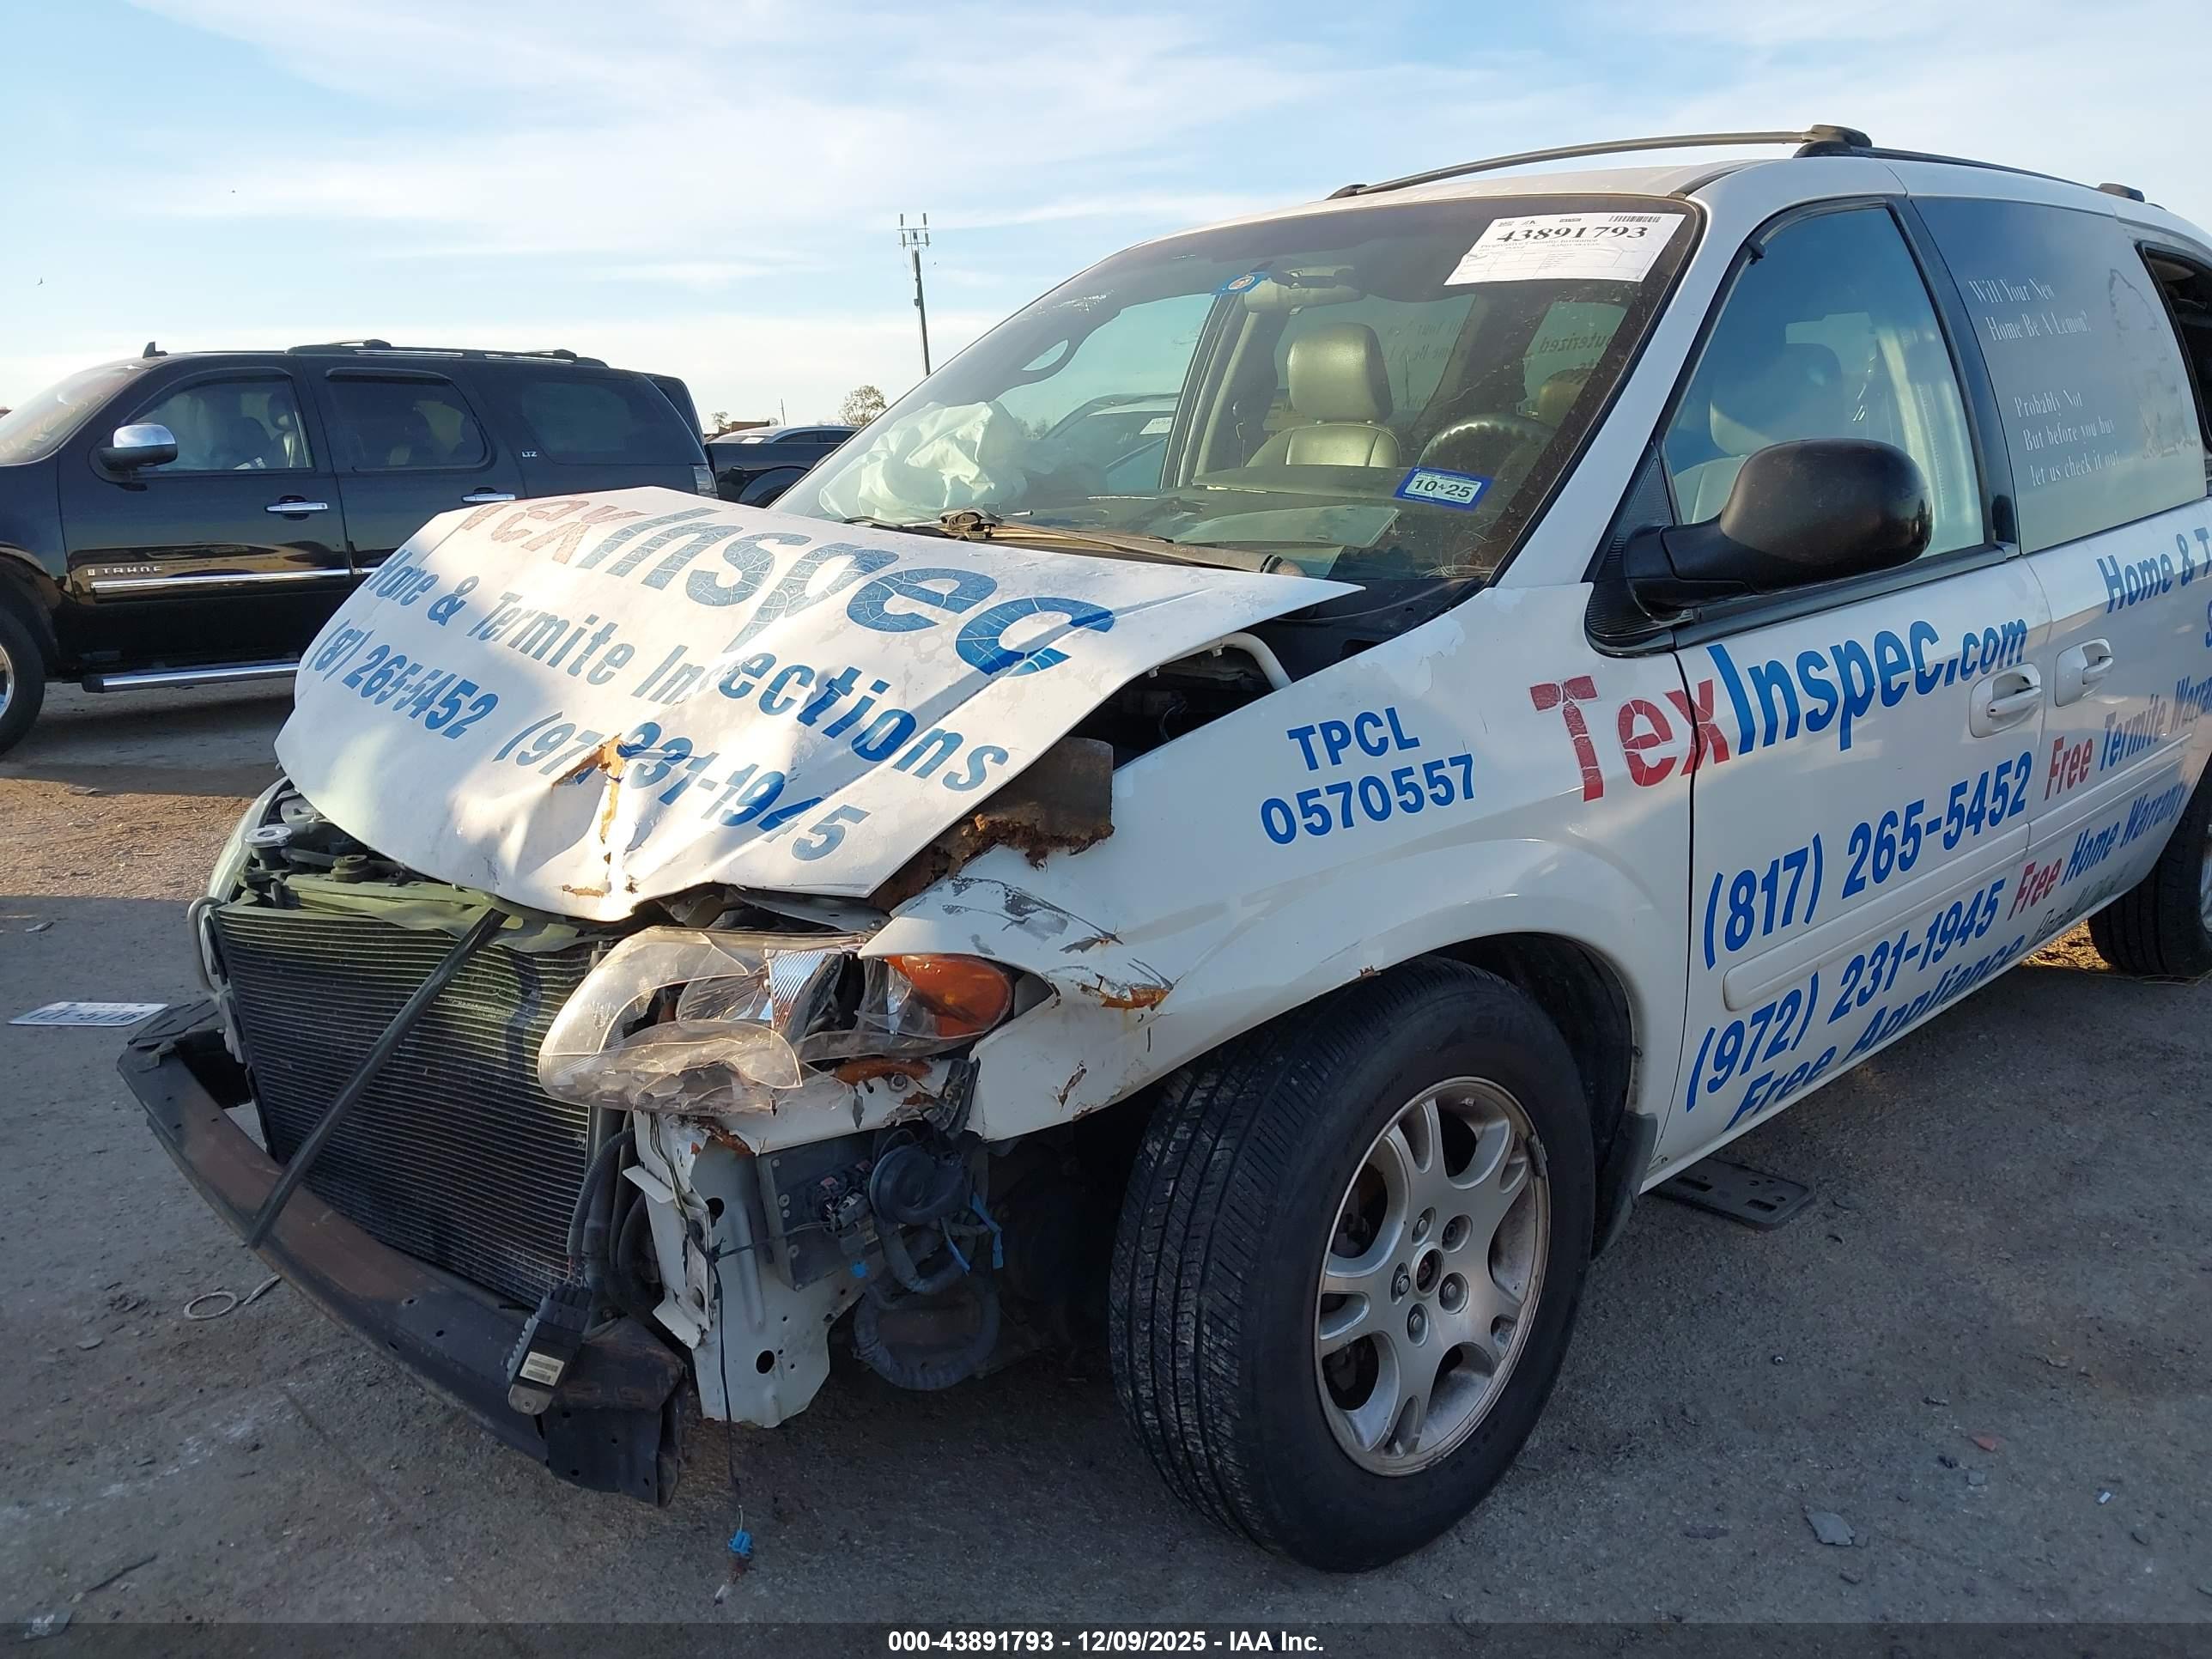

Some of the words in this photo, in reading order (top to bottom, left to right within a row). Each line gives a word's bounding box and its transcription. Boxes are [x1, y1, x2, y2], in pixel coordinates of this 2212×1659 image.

[1497, 226, 1648, 243] 43891793
[1985, 316, 2023, 341] Home
[2021, 313, 2041, 337] Be
[2022, 428, 2045, 451] But
[2045, 422, 2078, 445] before
[2063, 452, 2092, 477] check
[2097, 554, 2172, 613] Home
[2175, 533, 2196, 586] &
[427, 575, 480, 626] &
[465, 590, 635, 685] Termite
[629, 644, 1010, 793] Inections
[1528, 617, 2027, 803] TexInspec.com
[1286, 706, 1421, 771] TPCL
[1261, 752, 1474, 845] 0570557
[1703, 832, 1824, 971] (817)
[1841, 750, 2033, 900] 265-5452
[2044, 735, 2094, 801] Free
[2099, 693, 2167, 772] Termite
[1686, 969, 1820, 1114] (972)
[1826, 877, 2007, 1025] 231-1945
[2007, 858, 2063, 921] Free
[2061, 820, 2121, 887] Home
[1722, 1046, 1838, 1134] Free
[1839, 934, 2026, 1064] Appliance
